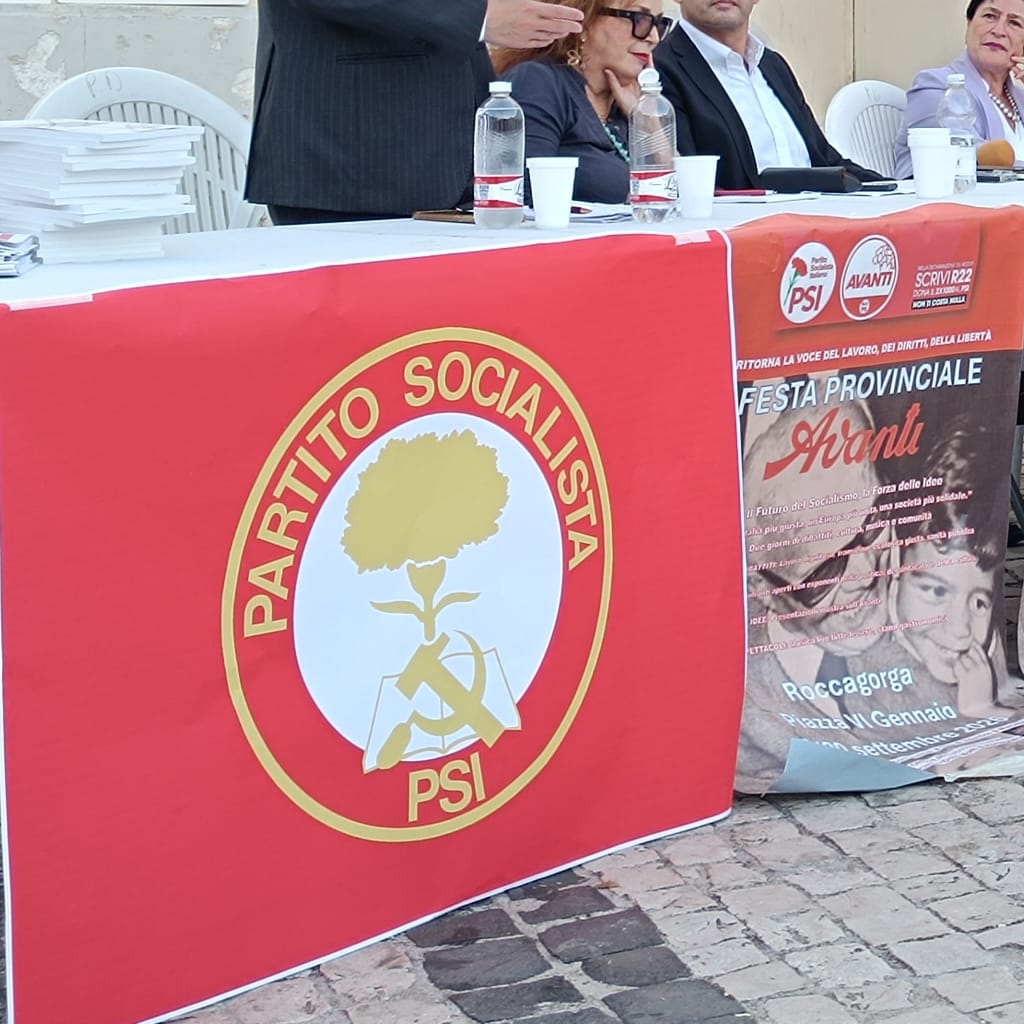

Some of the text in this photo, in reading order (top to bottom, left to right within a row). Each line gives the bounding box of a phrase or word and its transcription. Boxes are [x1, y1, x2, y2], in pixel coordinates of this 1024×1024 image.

[845, 271, 893, 290] AVANTI
[788, 284, 823, 314] PSI
[736, 357, 782, 370] RITORNA
[783, 355, 795, 366] LA
[796, 351, 821, 364] VOCE
[823, 349, 841, 361] DEL
[842, 344, 880, 357] LAVORO,
[881, 342, 896, 353] DEI
[930, 334, 955, 347] DELLA
[957, 328, 992, 344] LIBERTÀ
[739, 357, 984, 416] FESTA PROVINCIALE
[764, 402, 926, 481] Avanti
[243, 351, 600, 638] PARTITO SOCIALISTA
[755, 506, 789, 517] Futuro
[791, 501, 806, 512] del
[872, 484, 897, 496] Forza
[879, 503, 893, 512] una
[894, 498, 922, 510] società
[781, 667, 914, 702] Roccagorga
[779, 701, 958, 730] Piazza VI Gennaio
[851, 726, 960, 757] settembre
[408, 751, 487, 823] PSI
